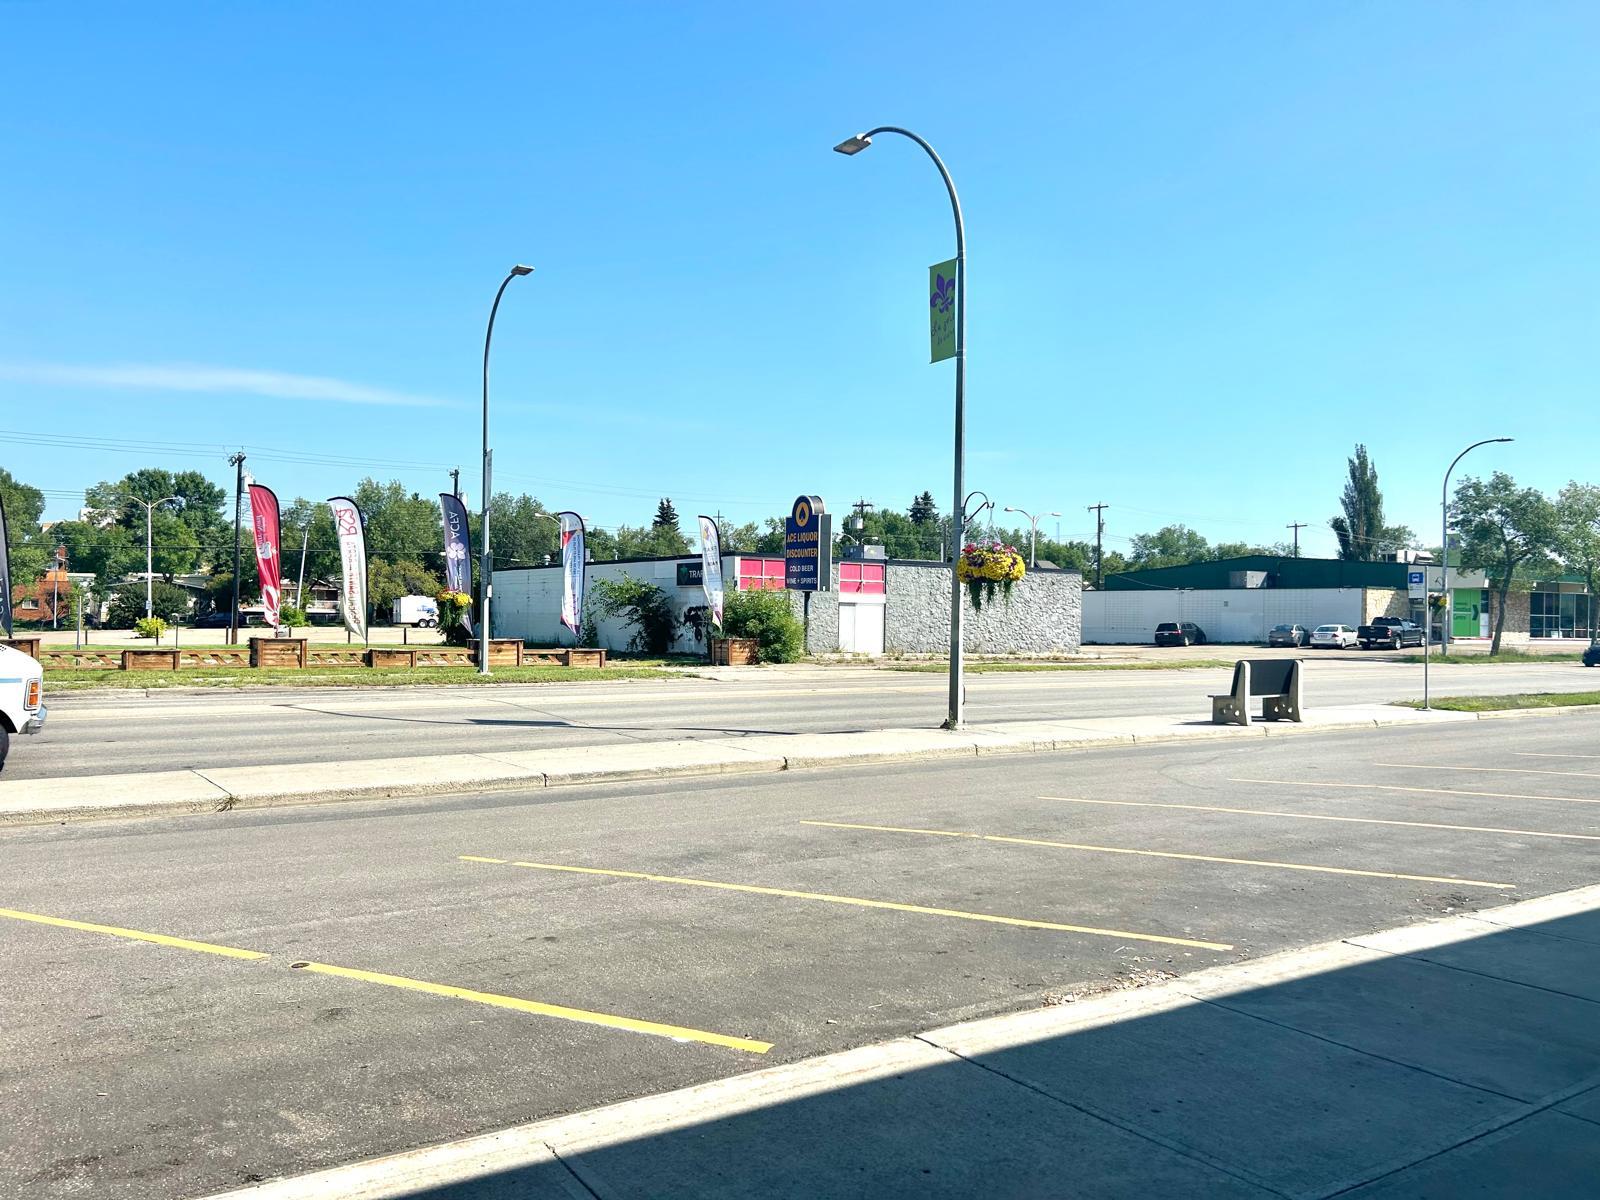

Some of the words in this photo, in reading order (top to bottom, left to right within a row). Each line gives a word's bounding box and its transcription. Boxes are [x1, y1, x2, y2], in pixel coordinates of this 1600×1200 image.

[787, 533, 796, 543] ACE
[798, 531, 818, 543] LIQUOR
[786, 548, 818, 558] DISCOUNTER
